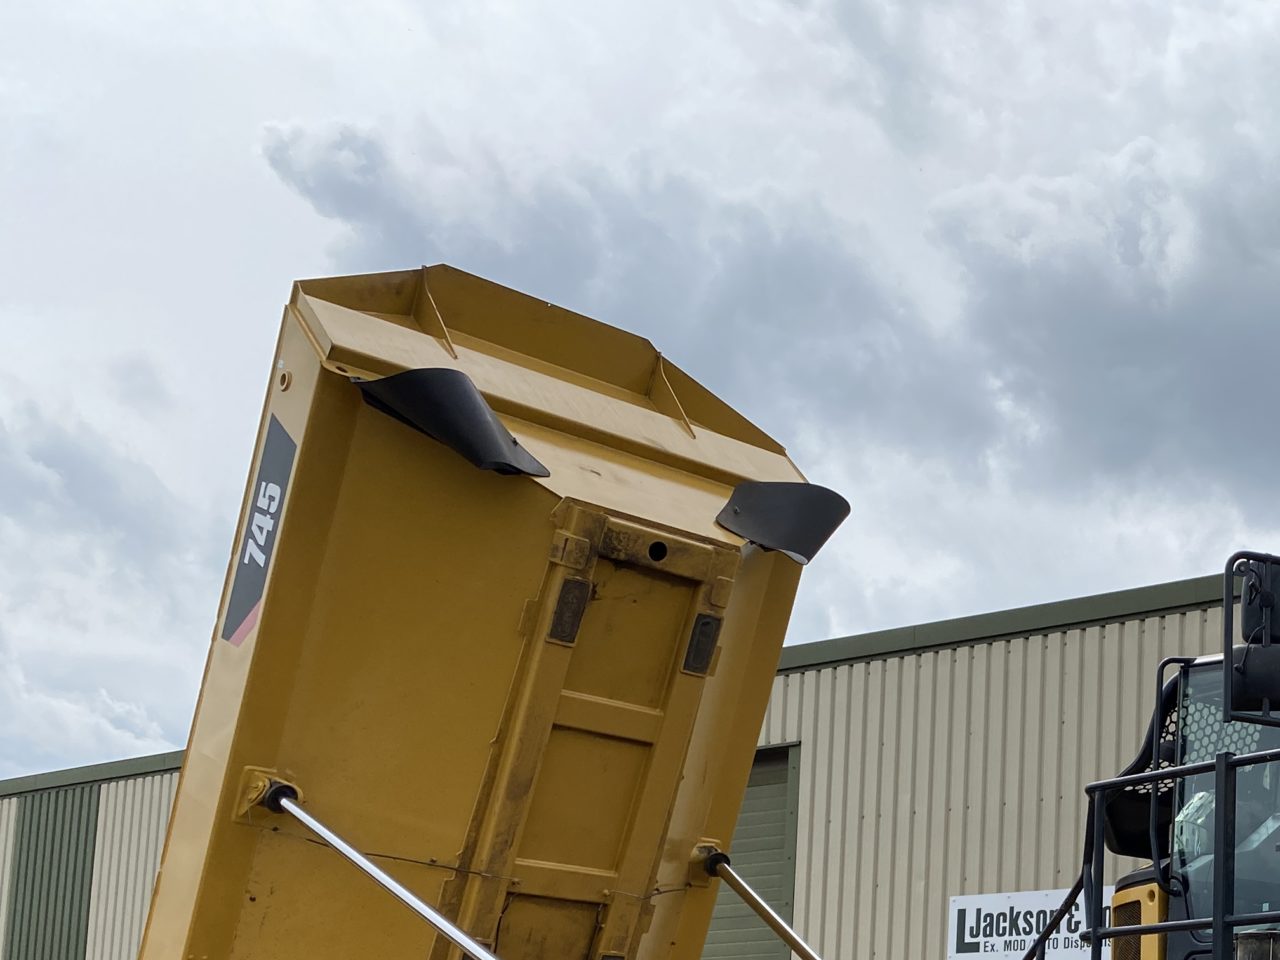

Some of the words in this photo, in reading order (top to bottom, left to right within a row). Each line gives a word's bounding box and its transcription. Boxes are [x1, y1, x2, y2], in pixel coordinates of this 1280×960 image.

[244, 481, 282, 568] 745
[983, 940, 999, 953] Ex.
[1003, 937, 1059, 952] MOD/TO
